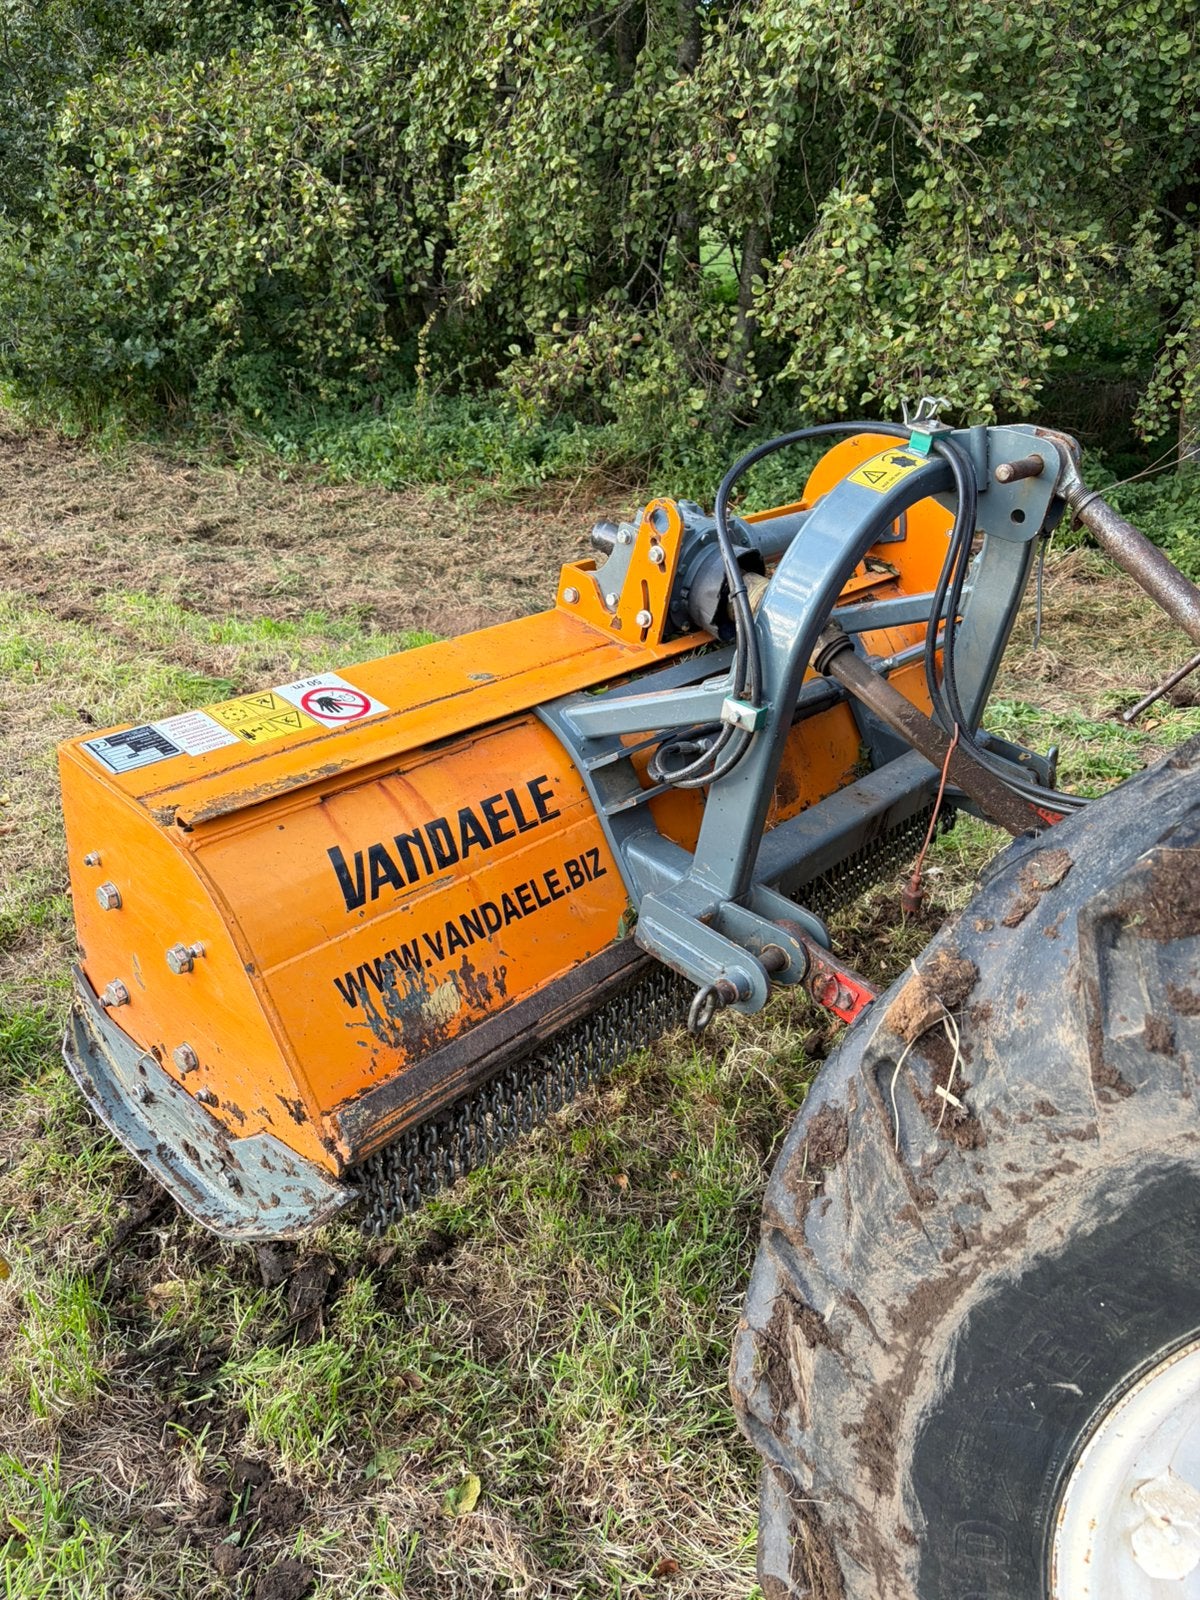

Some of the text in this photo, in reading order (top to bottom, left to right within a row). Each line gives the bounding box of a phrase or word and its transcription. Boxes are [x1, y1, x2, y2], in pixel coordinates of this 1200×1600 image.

[306, 679, 323, 687] 50
[327, 775, 561, 912] VANDAELE
[333, 848, 607, 1008] WWW.VANDAELE.BIZ
